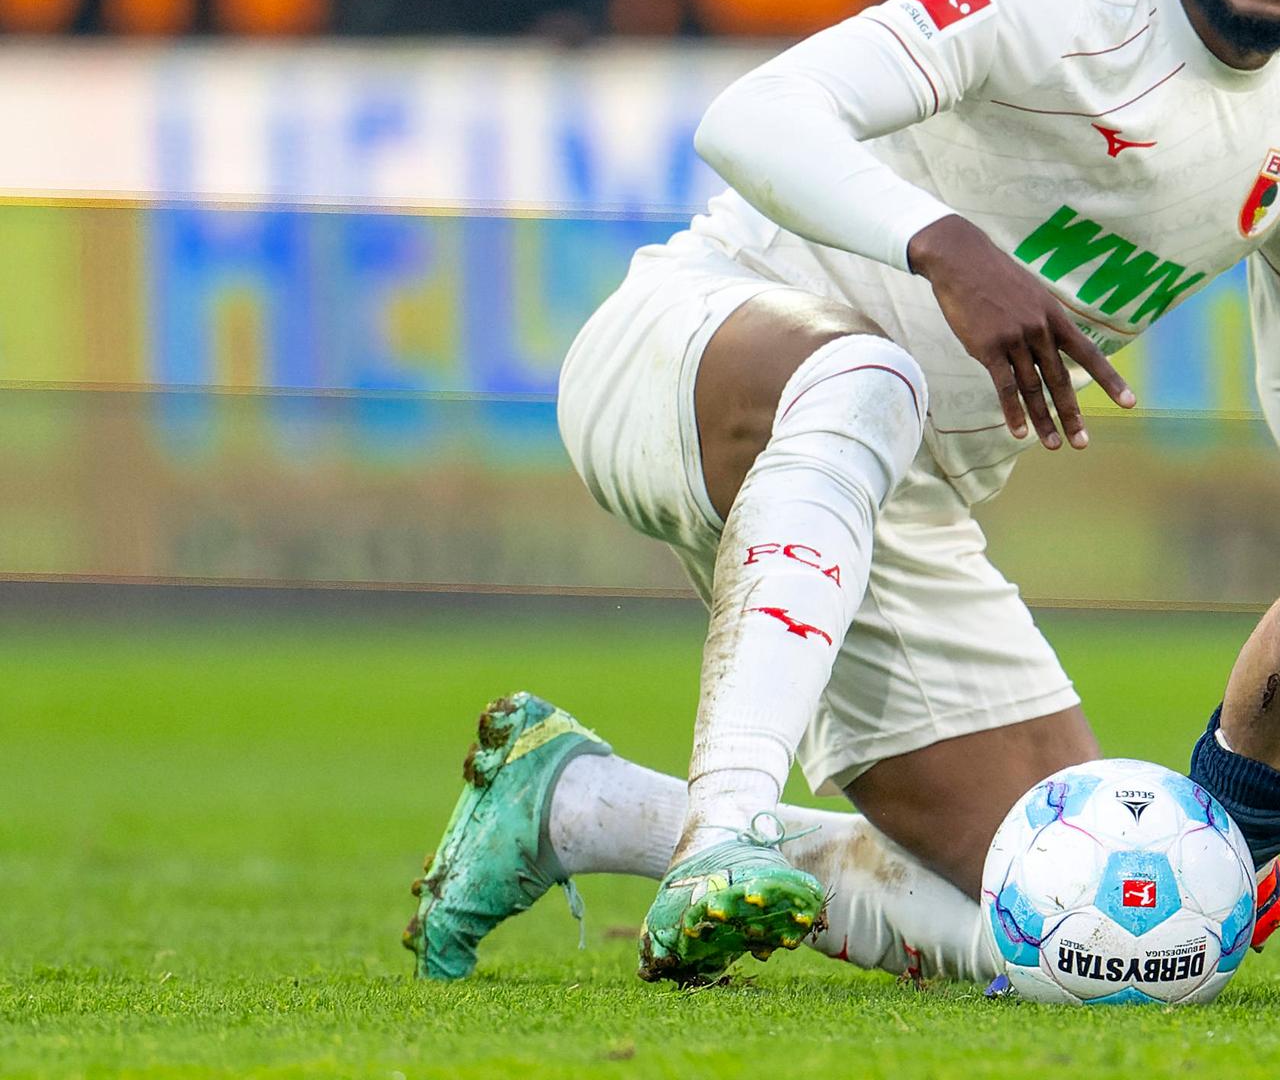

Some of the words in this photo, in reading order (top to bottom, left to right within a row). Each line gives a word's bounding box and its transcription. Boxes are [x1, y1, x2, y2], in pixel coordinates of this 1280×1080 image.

[1012, 204, 1208, 325] WWK
[742, 542, 842, 589] FCA
[1115, 790, 1155, 800] SELECT
[1057, 945, 1208, 984] DERBYSTAR
[1144, 943, 1199, 958] BUNDESLIGA
